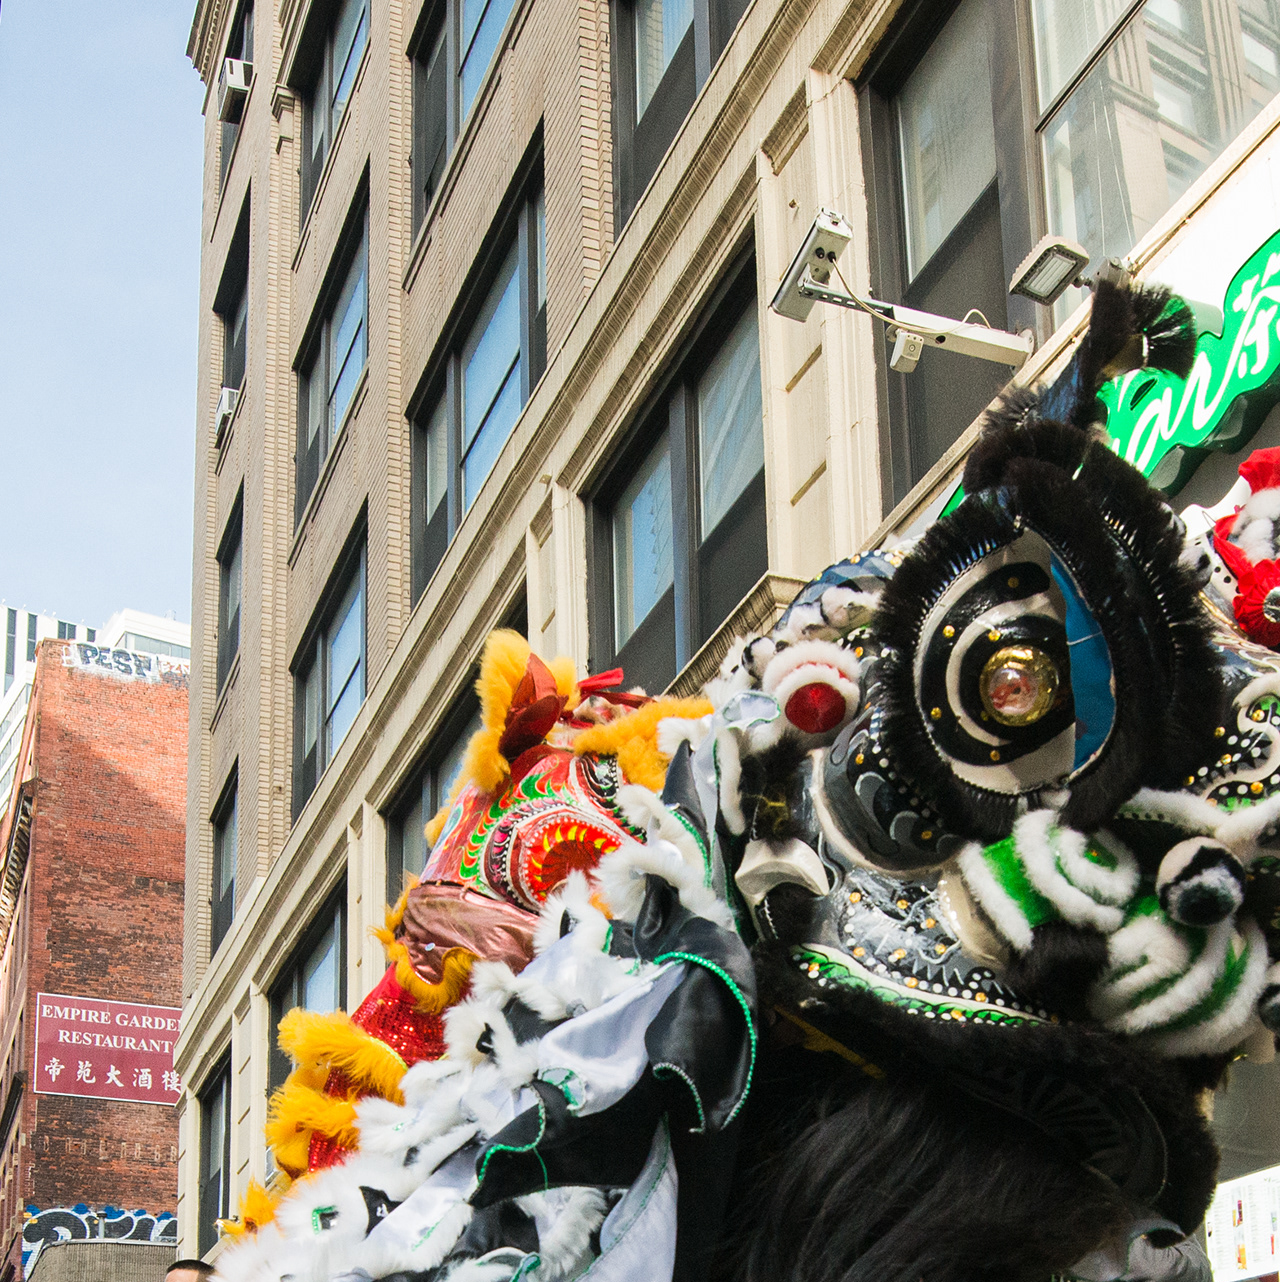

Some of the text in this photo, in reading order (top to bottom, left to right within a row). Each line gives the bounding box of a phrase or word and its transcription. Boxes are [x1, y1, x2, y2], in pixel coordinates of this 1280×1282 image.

[42, 1005, 181, 1032] EMPIRE GARDE
[58, 1029, 173, 1053] RESTAURANT
